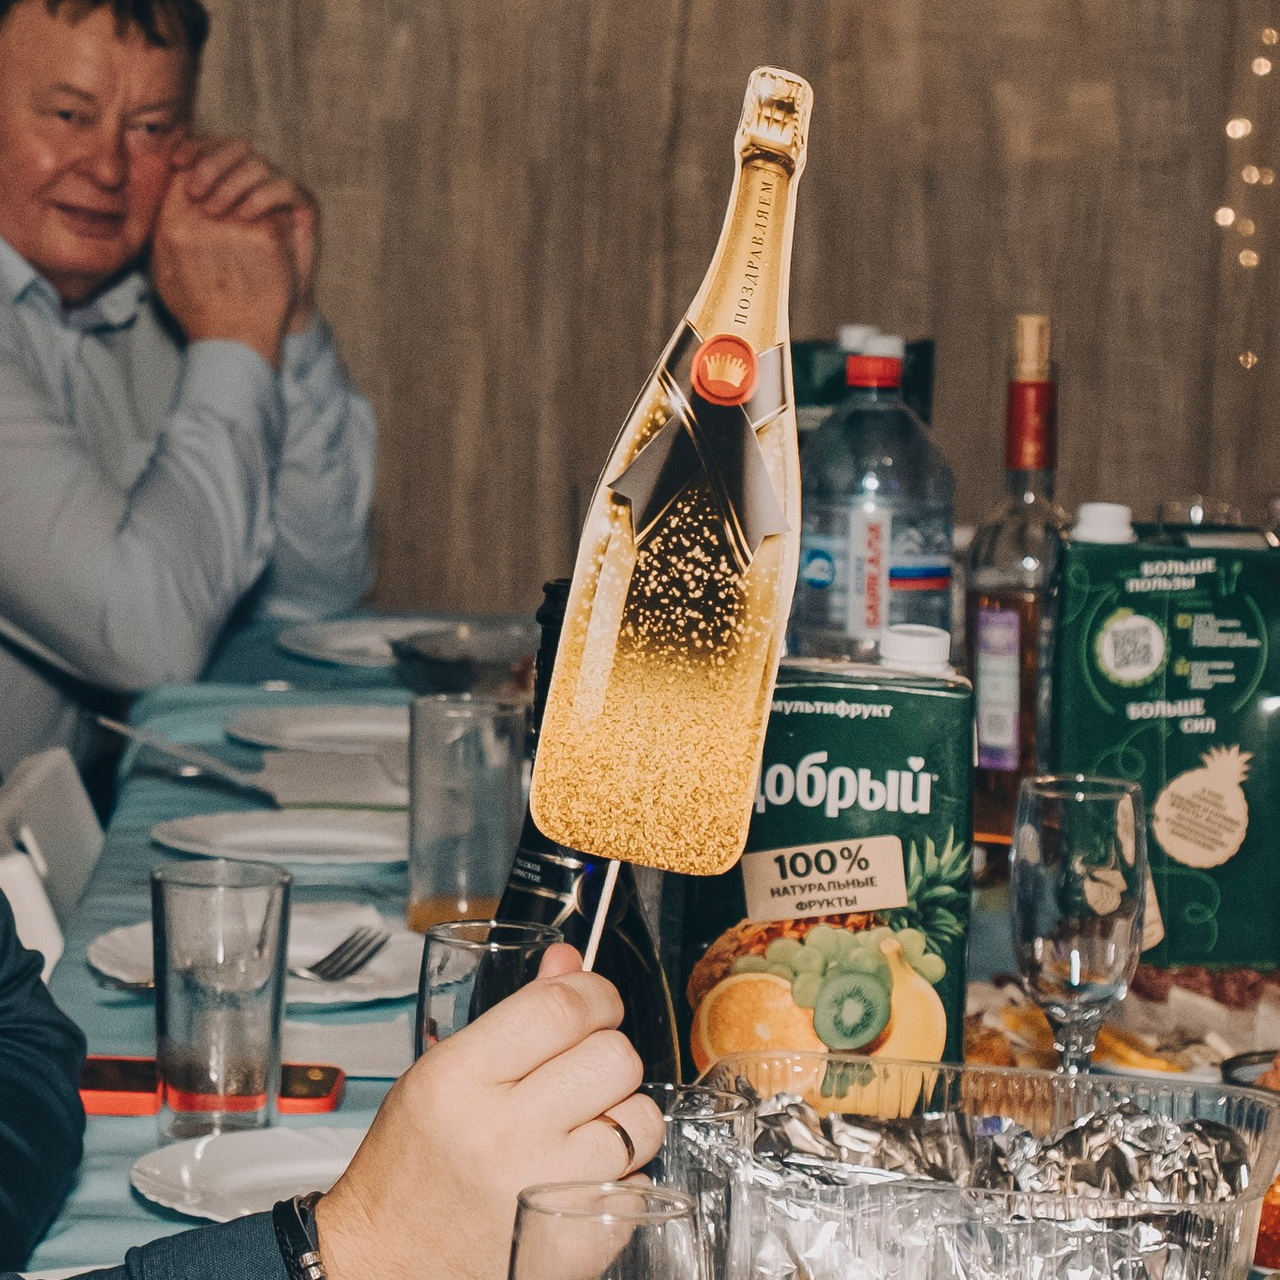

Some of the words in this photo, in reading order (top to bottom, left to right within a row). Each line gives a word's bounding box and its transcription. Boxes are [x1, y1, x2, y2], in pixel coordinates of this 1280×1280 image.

[734, 181, 773, 325] ПОЗДРАВЛЯЕМ
[1140, 557, 1217, 577] БОЛЬШЕ
[1125, 576, 1196, 593] ПОЛЬЗЫ
[1126, 698, 1206, 720] БОЛЬШЕ
[1179, 718, 1217, 734] СИЛ
[774, 845, 870, 881] 100%
[770, 876, 877, 898] НАТУРАЛЬНЫЕ
[795, 895, 858, 912] ФРУКТЫ
